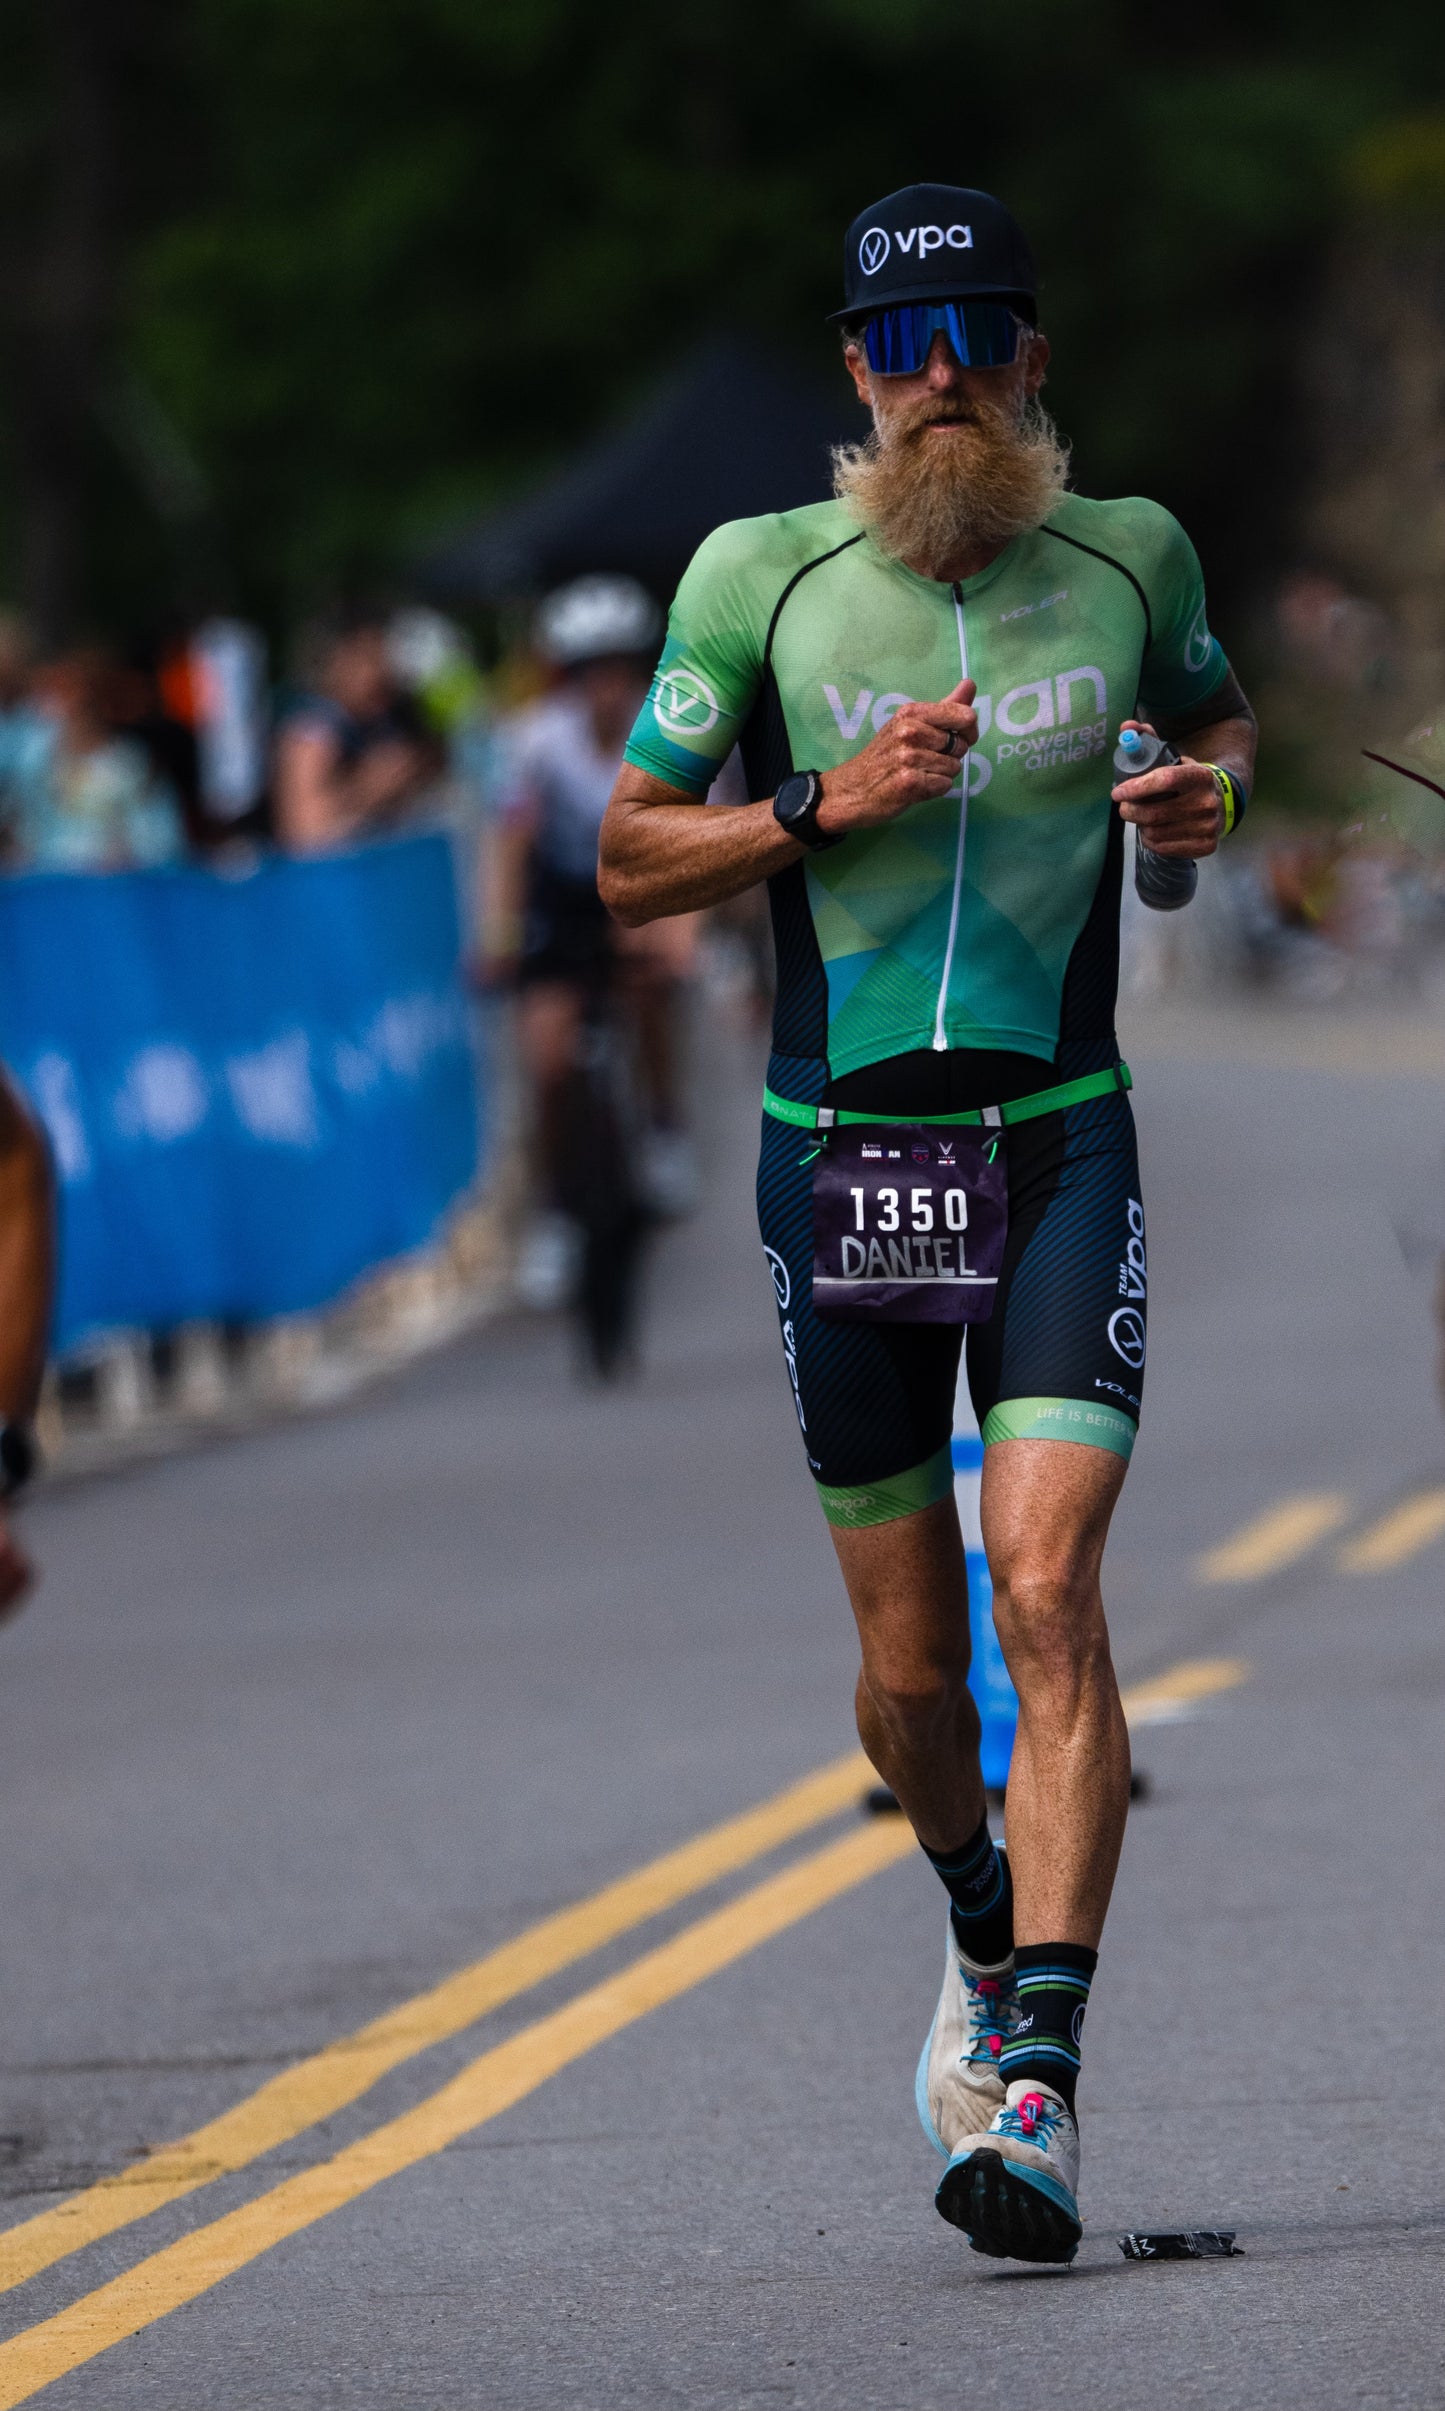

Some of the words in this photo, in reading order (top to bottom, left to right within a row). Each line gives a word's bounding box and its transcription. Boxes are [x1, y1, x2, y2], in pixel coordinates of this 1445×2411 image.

[895, 225, 974, 259] vpa
[997, 719, 1107, 764] powered
[850, 1187, 968, 1232] 1350
[841, 1235, 978, 1279] DANIEL
[1118, 1263, 1129, 1296] TEAM
[1036, 1407, 1064, 1420] LIFE
[1069, 1410, 1082, 1422] IS
